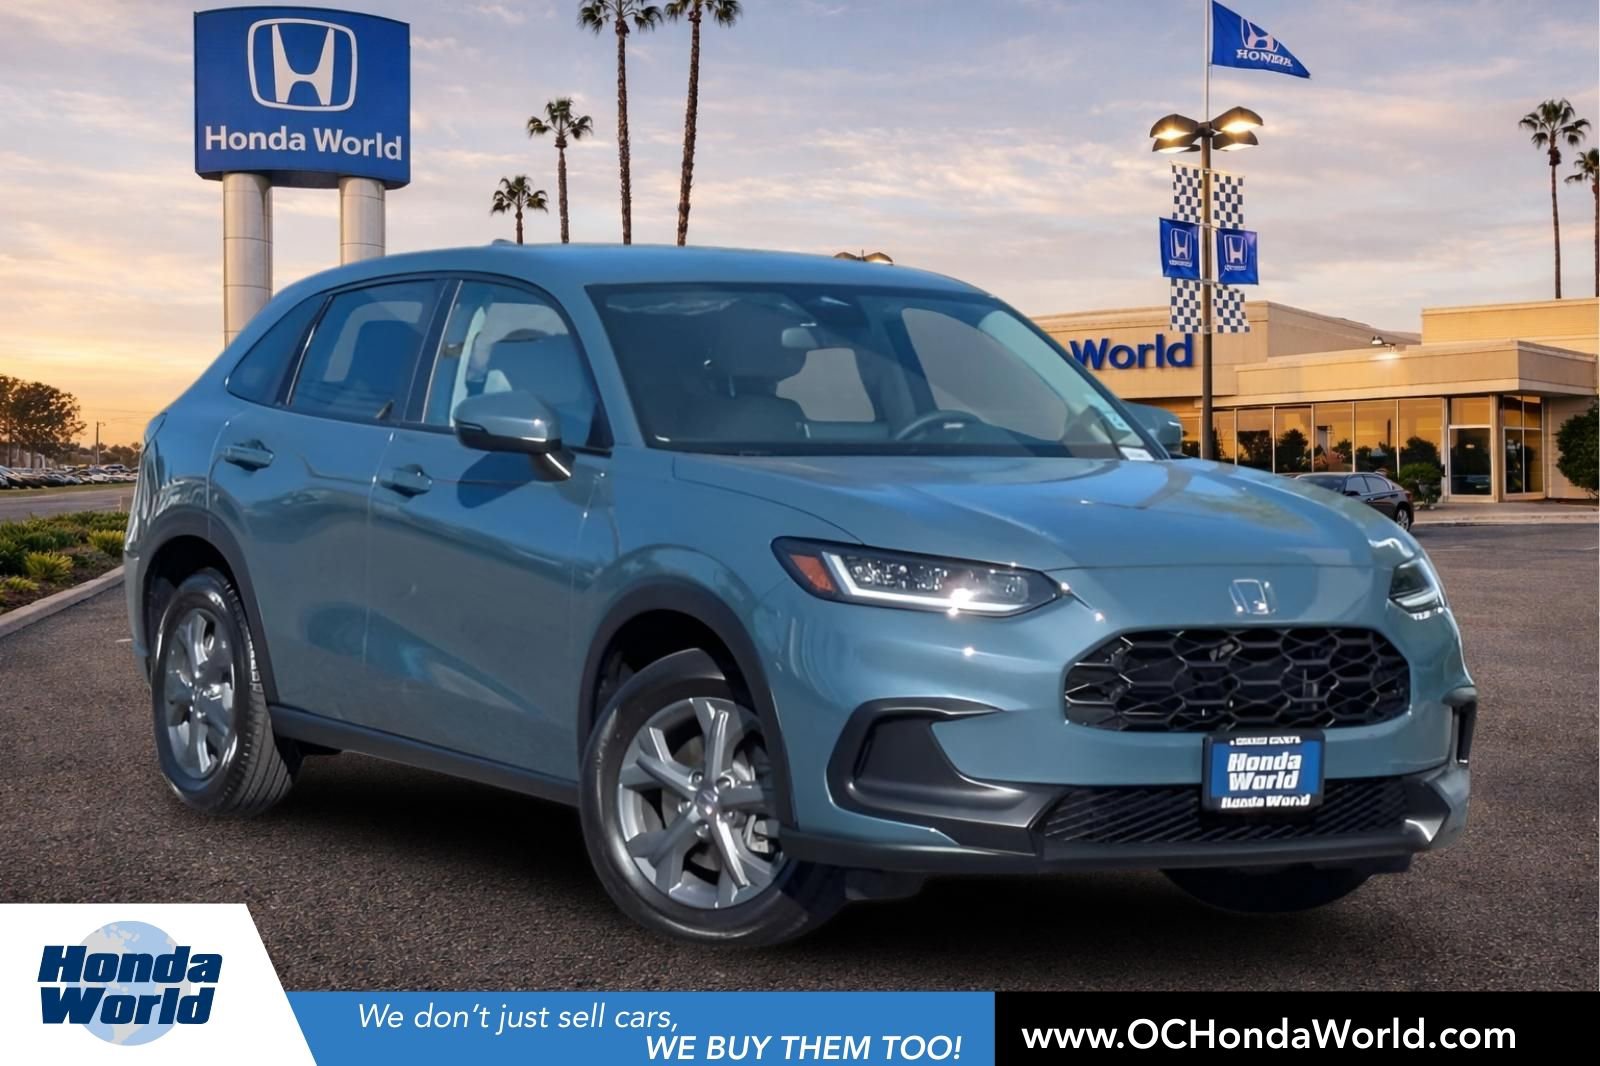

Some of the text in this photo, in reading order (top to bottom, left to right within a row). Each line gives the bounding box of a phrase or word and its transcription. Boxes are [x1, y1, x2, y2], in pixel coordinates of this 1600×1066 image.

[205, 125, 402, 160] Honda World
[1069, 333, 1193, 370] World
[1227, 751, 1302, 772] Honda
[1229, 770, 1299, 791] World
